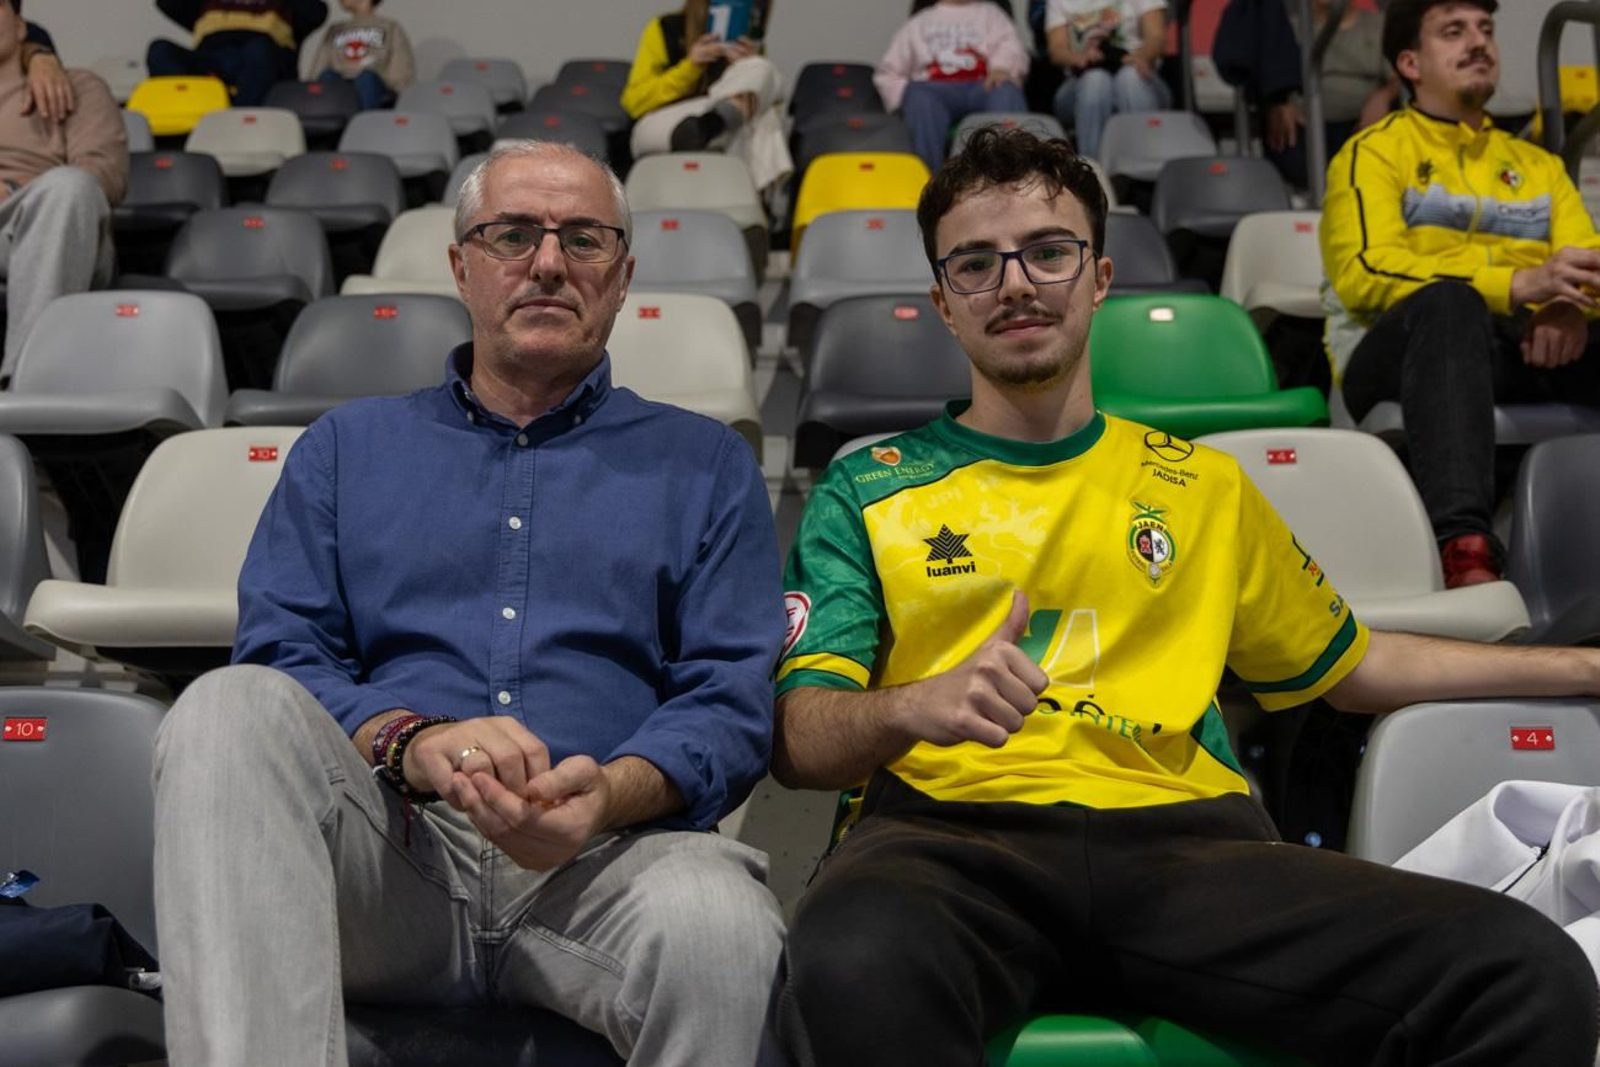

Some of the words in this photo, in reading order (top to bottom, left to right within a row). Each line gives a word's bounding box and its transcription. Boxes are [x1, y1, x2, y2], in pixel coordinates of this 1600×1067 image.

[855, 469, 892, 483] GREEN
[1152, 468, 1186, 487] JADISA
[926, 561, 976, 578] luanvi
[17, 722, 34, 737] 10
[1526, 731, 1538, 746] 4
